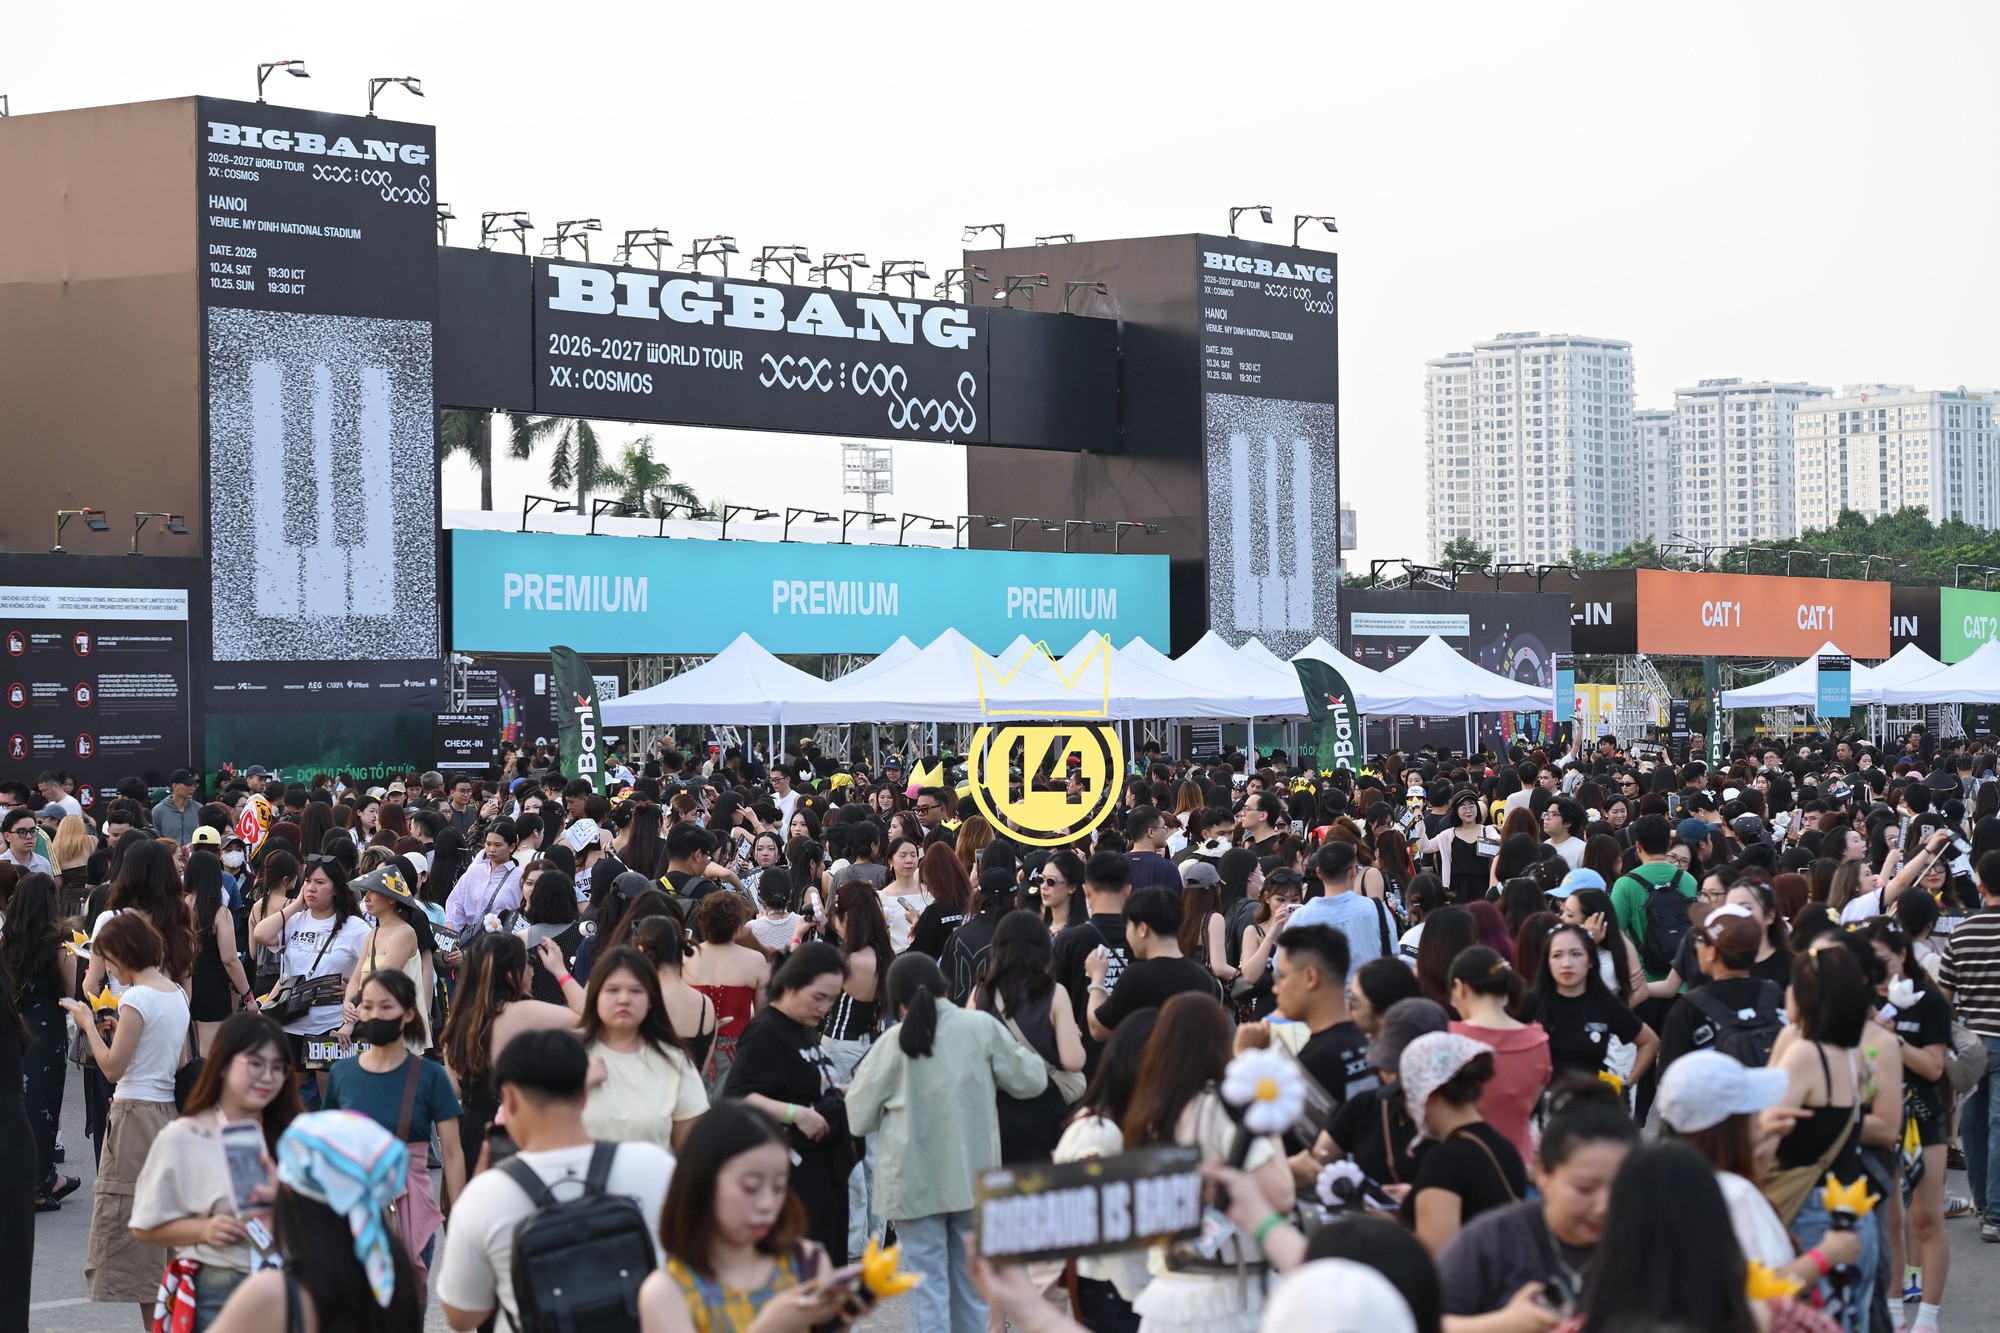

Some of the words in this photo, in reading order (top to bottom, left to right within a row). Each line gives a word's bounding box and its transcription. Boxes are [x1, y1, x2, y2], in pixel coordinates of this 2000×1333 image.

[207, 121, 430, 166] BIGBANG
[208, 152, 254, 167] 2026-2027
[284, 160, 305, 172] TOUR
[208, 167, 220, 178] XX
[224, 168, 260, 182] COSMOS
[208, 194, 248, 212] HANOI
[210, 216, 241, 229] VENUE.
[242, 219, 257, 231] MY
[258, 220, 280, 233] DINH
[280, 222, 323, 238] NATIONAL
[324, 226, 362, 240] STADIUM
[209, 244, 234, 257] DATE.
[235, 246, 257, 259] 2026
[236, 264, 252, 276] SAT
[268, 266, 290, 279] 19:30
[291, 268, 306, 280] ICT
[1203, 252, 1334, 284] BIGBANG
[236, 280, 254, 292] SUN
[268, 282, 290, 294] 19:30
[291, 284, 306, 295] ICT
[1214, 287, 1234, 297] COSMOS
[1248, 281, 1260, 290] TOUR
[548, 264, 977, 350] BIGBANG
[1204, 307, 1228, 320] HANOI
[1224, 326, 1234, 334] MY
[1234, 328, 1246, 336] DINH
[1246, 329, 1271, 338] NATIONAL
[1271, 332, 1294, 341] STADIUM
[549, 333, 642, 363] 2026-2027
[702, 348, 744, 371] TOUR
[1220, 347, 1234, 356] 2026
[1220, 360, 1230, 368] SAT
[550, 366, 572, 389] XX
[582, 368, 653, 394] COSMOS
[1221, 372, 1232, 381] SUN
[503, 573, 648, 612] PREMIUM
[772, 580, 899, 616] PREMIUM
[1006, 586, 1118, 620] PREMIUM
[1701, 600, 1733, 628] CAT
[1797, 604, 1825, 630] CAT
[1964, 615, 1987, 640] CAT
[1990, 618, 1998, 640] 2
[444, 740, 484, 748] CHECK-IN
[574, 694, 598, 793] PBank
[1327, 694, 1357, 772] PBank
[1102, 1180, 1131, 1243] IS
